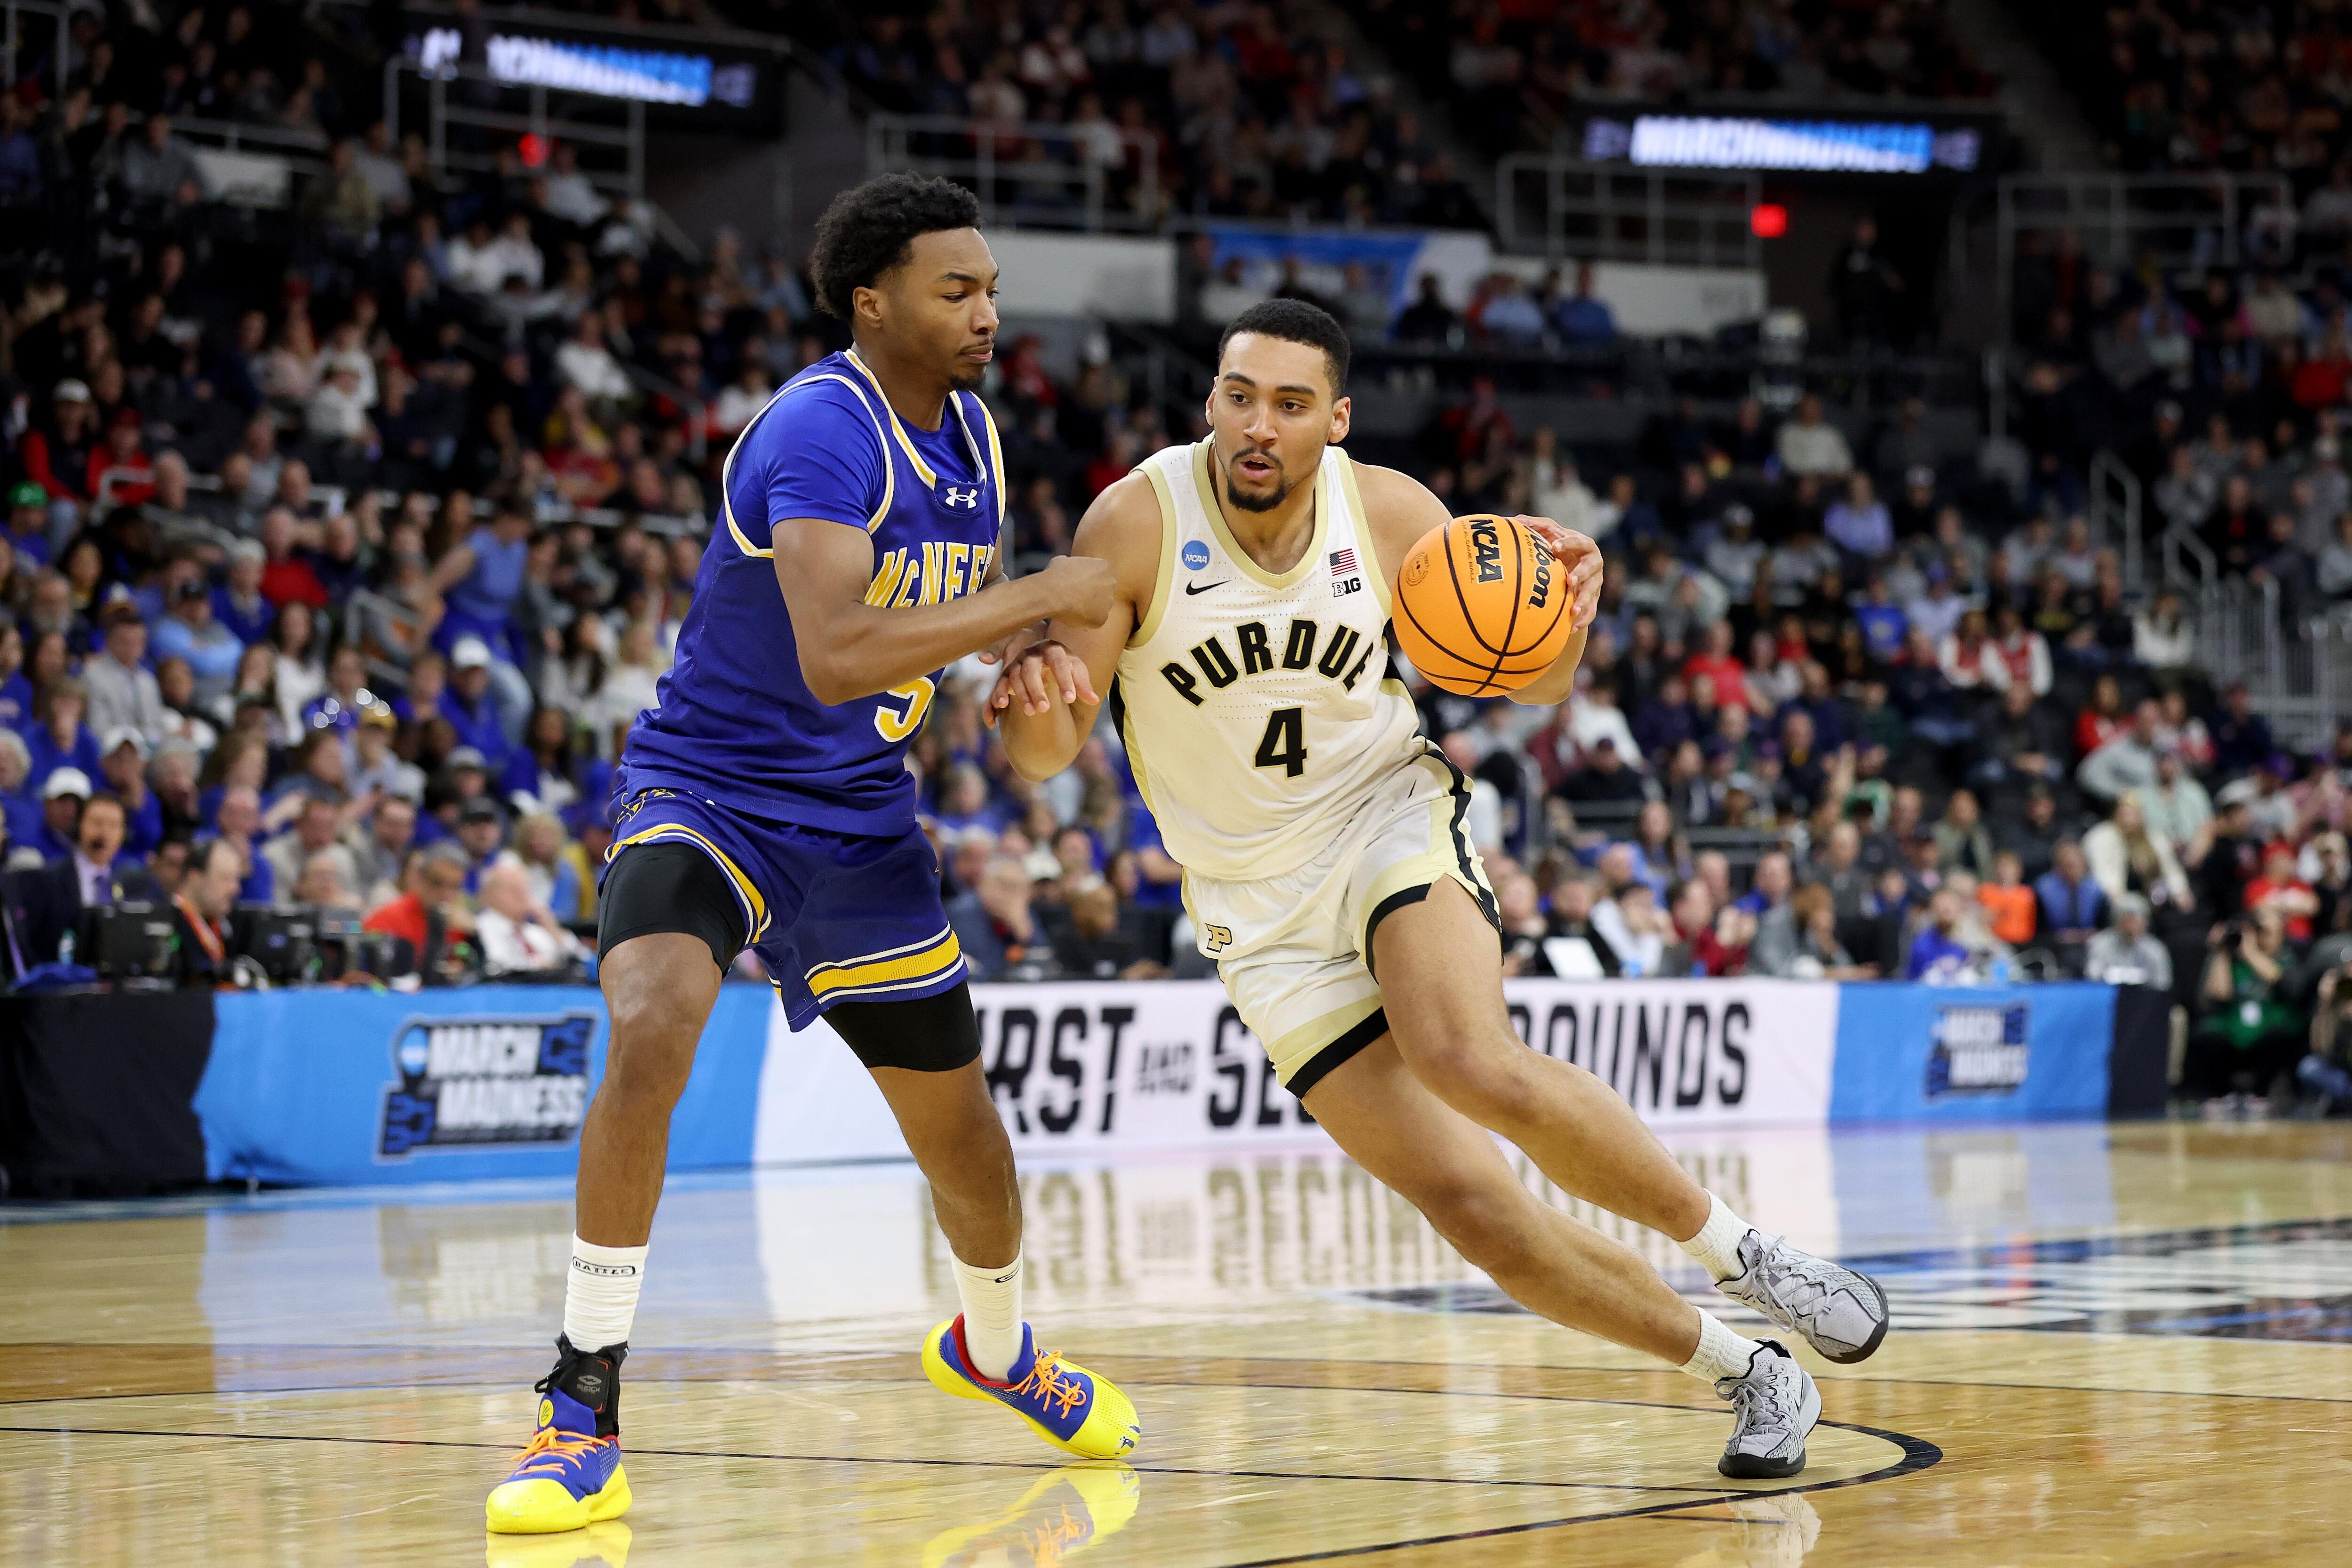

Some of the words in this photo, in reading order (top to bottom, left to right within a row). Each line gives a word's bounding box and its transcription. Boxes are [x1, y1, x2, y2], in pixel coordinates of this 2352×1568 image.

[1185, 554, 1207, 564] NCAA
[1469, 519, 1503, 583] NCAA
[1524, 525, 1556, 608] ilson
[1159, 618, 1374, 708] PURDUE
[1253, 705, 1309, 780] 4
